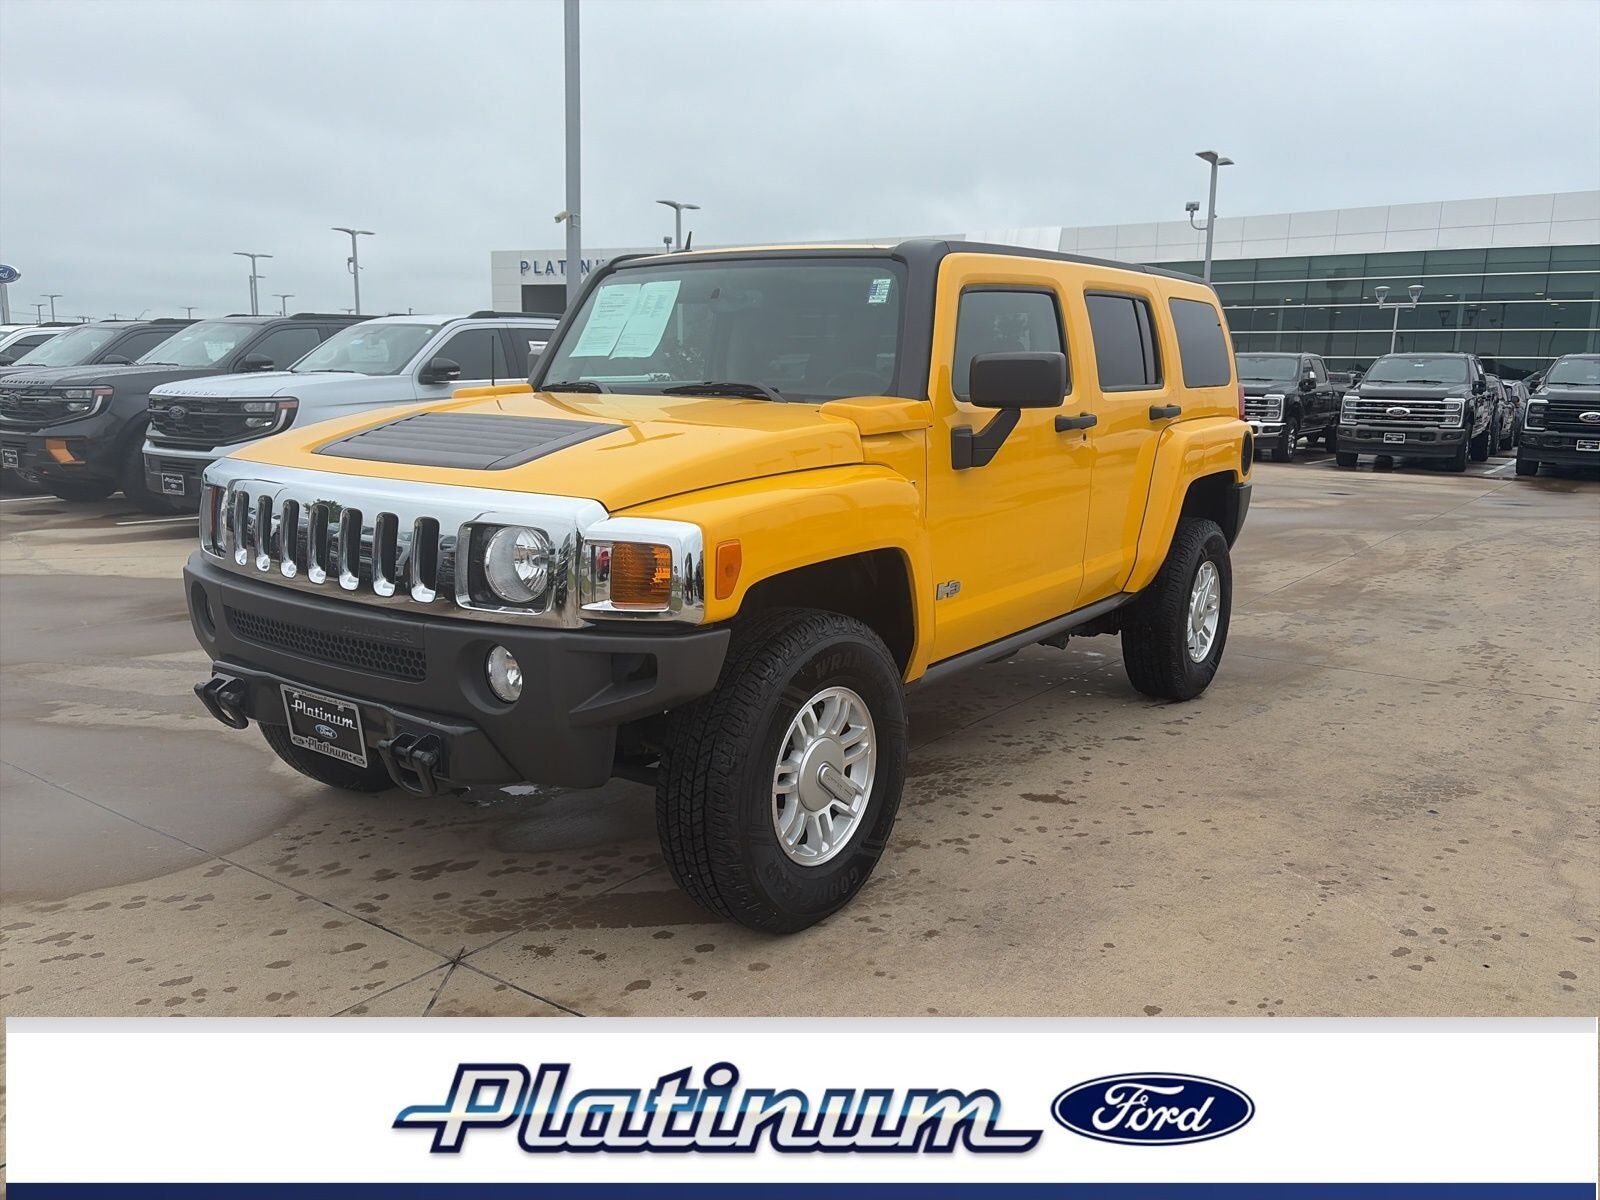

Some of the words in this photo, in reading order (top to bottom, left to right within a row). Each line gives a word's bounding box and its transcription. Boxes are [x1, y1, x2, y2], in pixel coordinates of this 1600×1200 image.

[520, 259, 605, 275] PLATN
[290, 699, 358, 730] Platinum
[305, 736, 354, 759] Platinum
